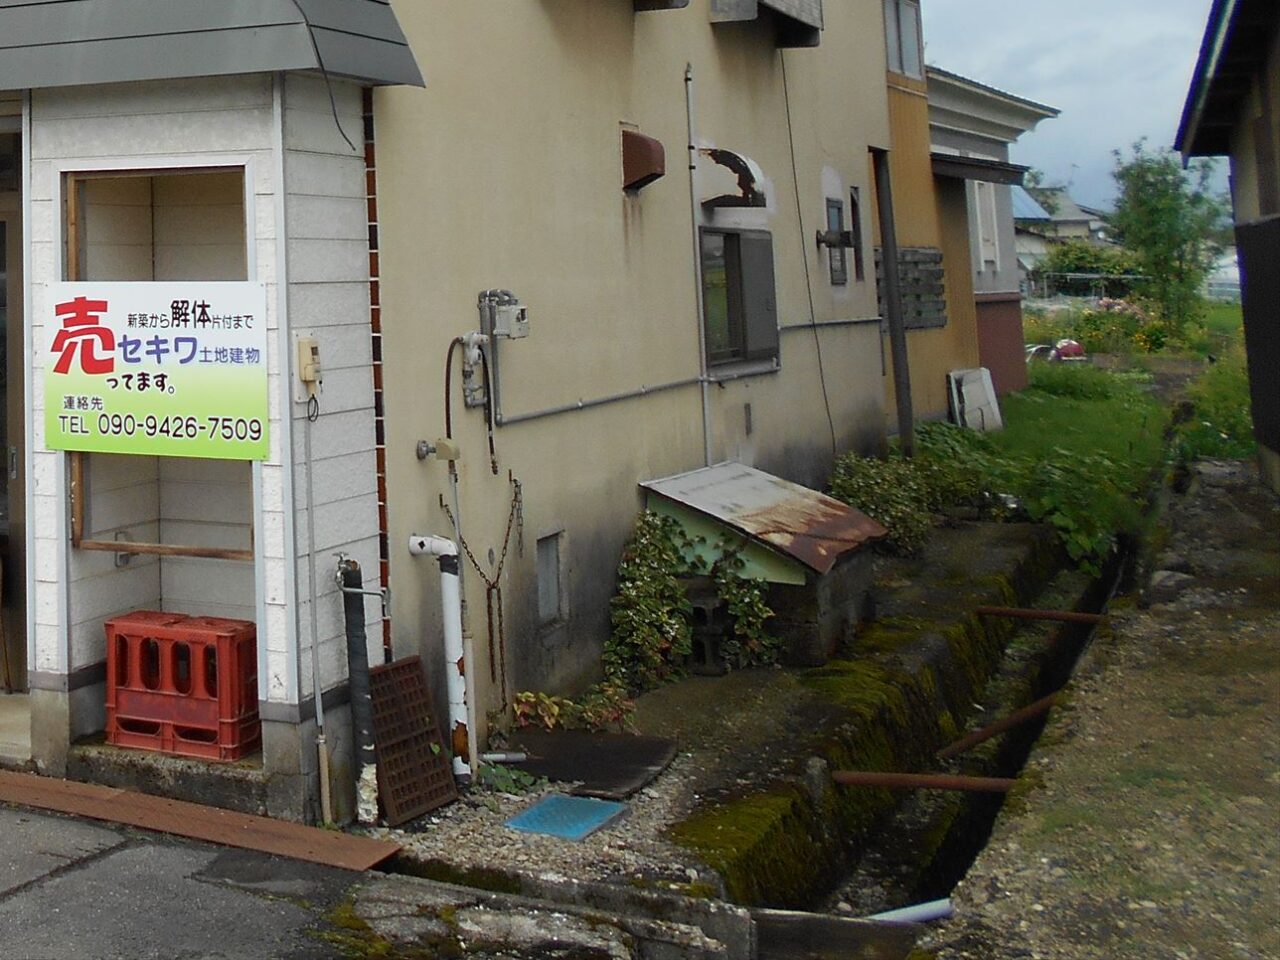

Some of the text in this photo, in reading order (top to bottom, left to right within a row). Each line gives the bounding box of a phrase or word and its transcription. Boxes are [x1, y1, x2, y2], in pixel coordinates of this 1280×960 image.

[127, 300, 254, 330] 新築から解体片付まで
[50, 296, 115, 375] 売
[106, 372, 175, 394] ってます。
[63, 396, 104, 411] 連絡先
[59, 413, 262, 441] TEL 090-9426-7509
